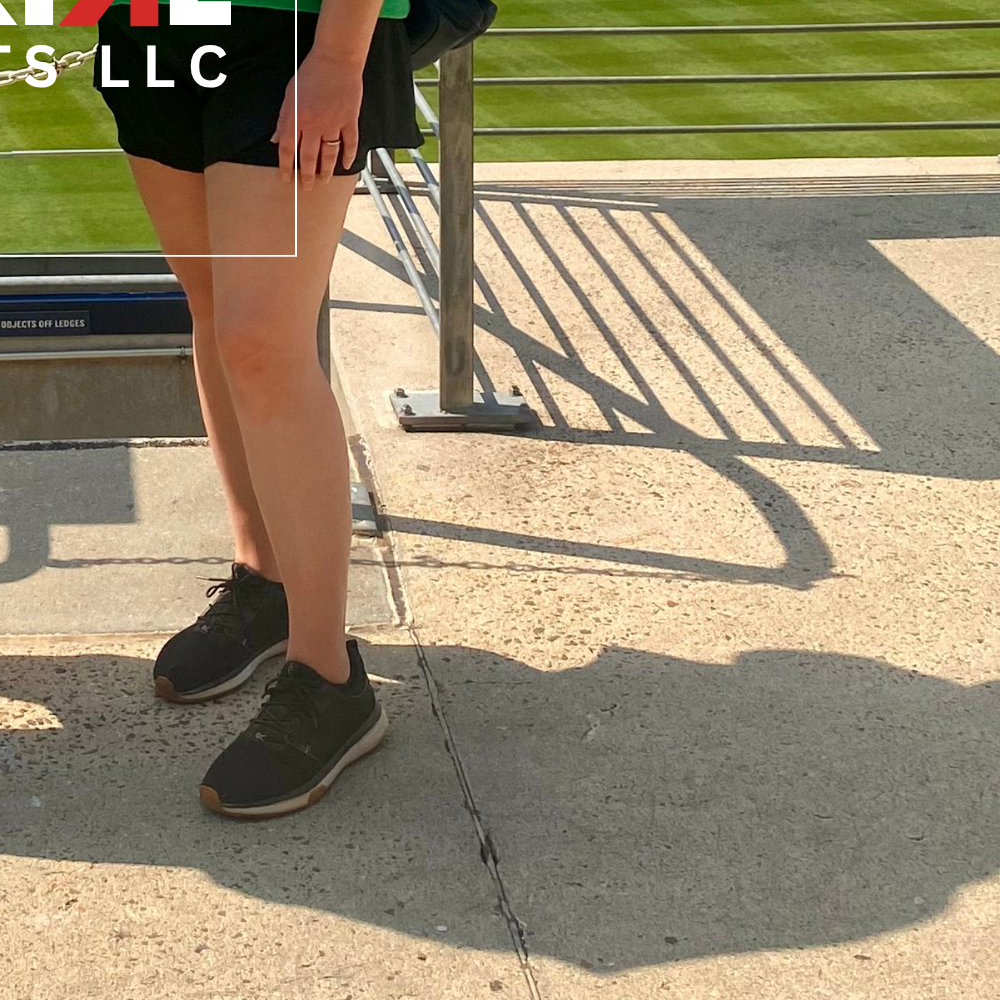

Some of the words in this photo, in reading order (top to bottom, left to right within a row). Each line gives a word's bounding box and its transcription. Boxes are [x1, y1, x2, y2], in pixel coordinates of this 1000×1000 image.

[1, 320, 37, 329] OBJECTS
[38, 319, 53, 328] OFF
[55, 319, 85, 328] LEDGES
